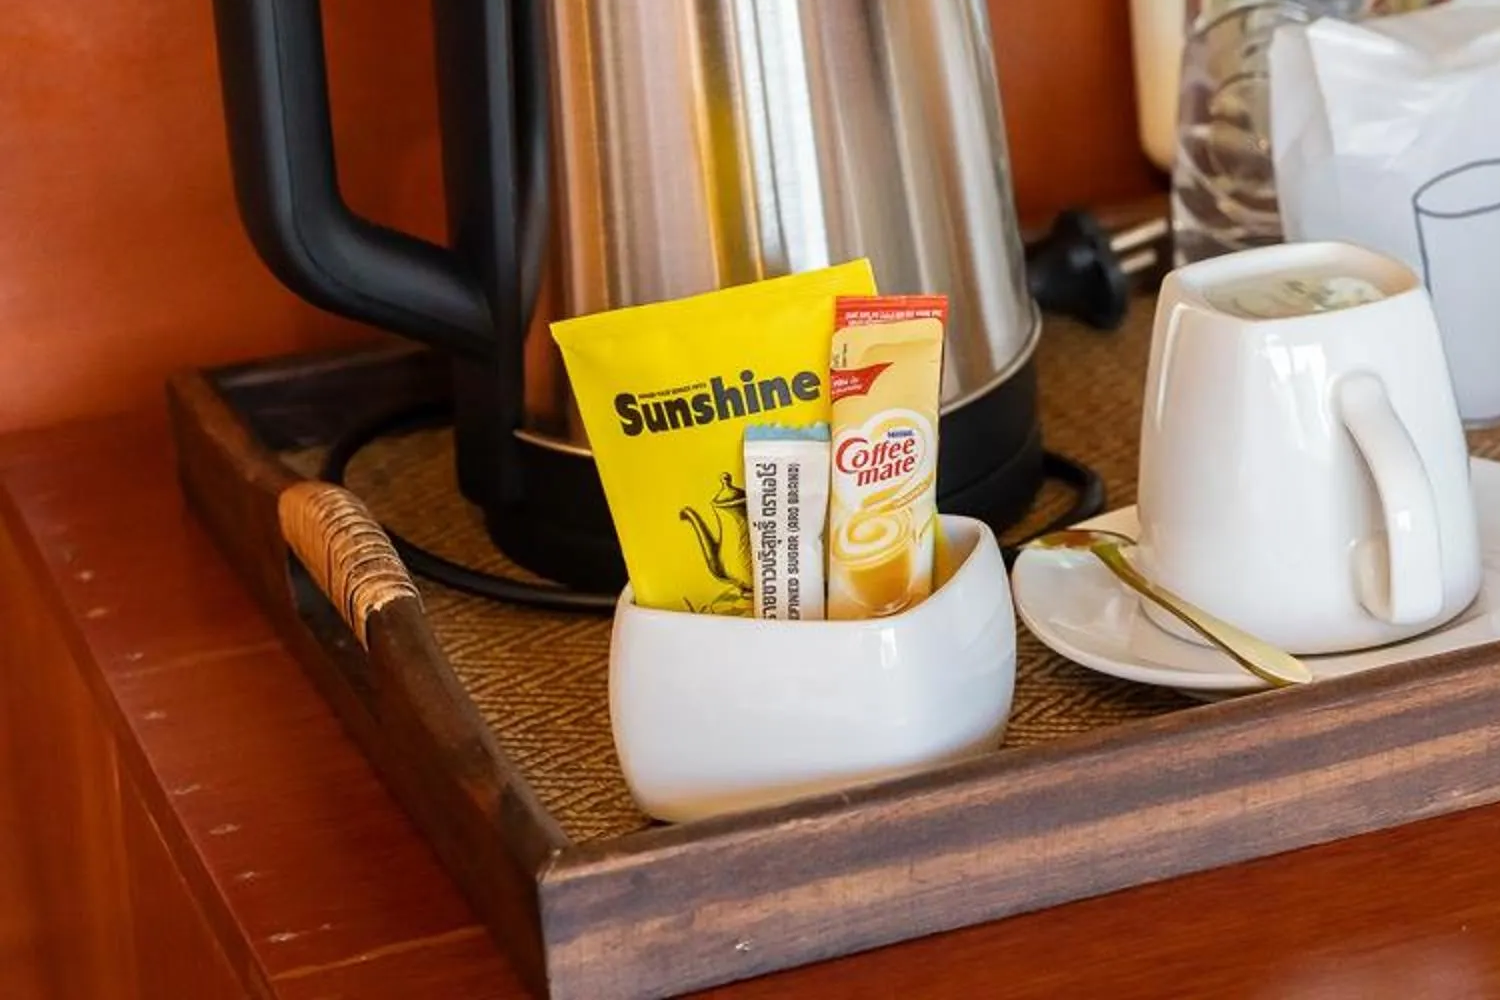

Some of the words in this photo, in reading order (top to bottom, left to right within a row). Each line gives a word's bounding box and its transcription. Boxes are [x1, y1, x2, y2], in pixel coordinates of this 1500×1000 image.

[614, 369, 821, 437] Sunshine
[836, 438, 916, 475] Coffee
[857, 455, 915, 486] mate
[787, 535, 800, 575] SUGAR
